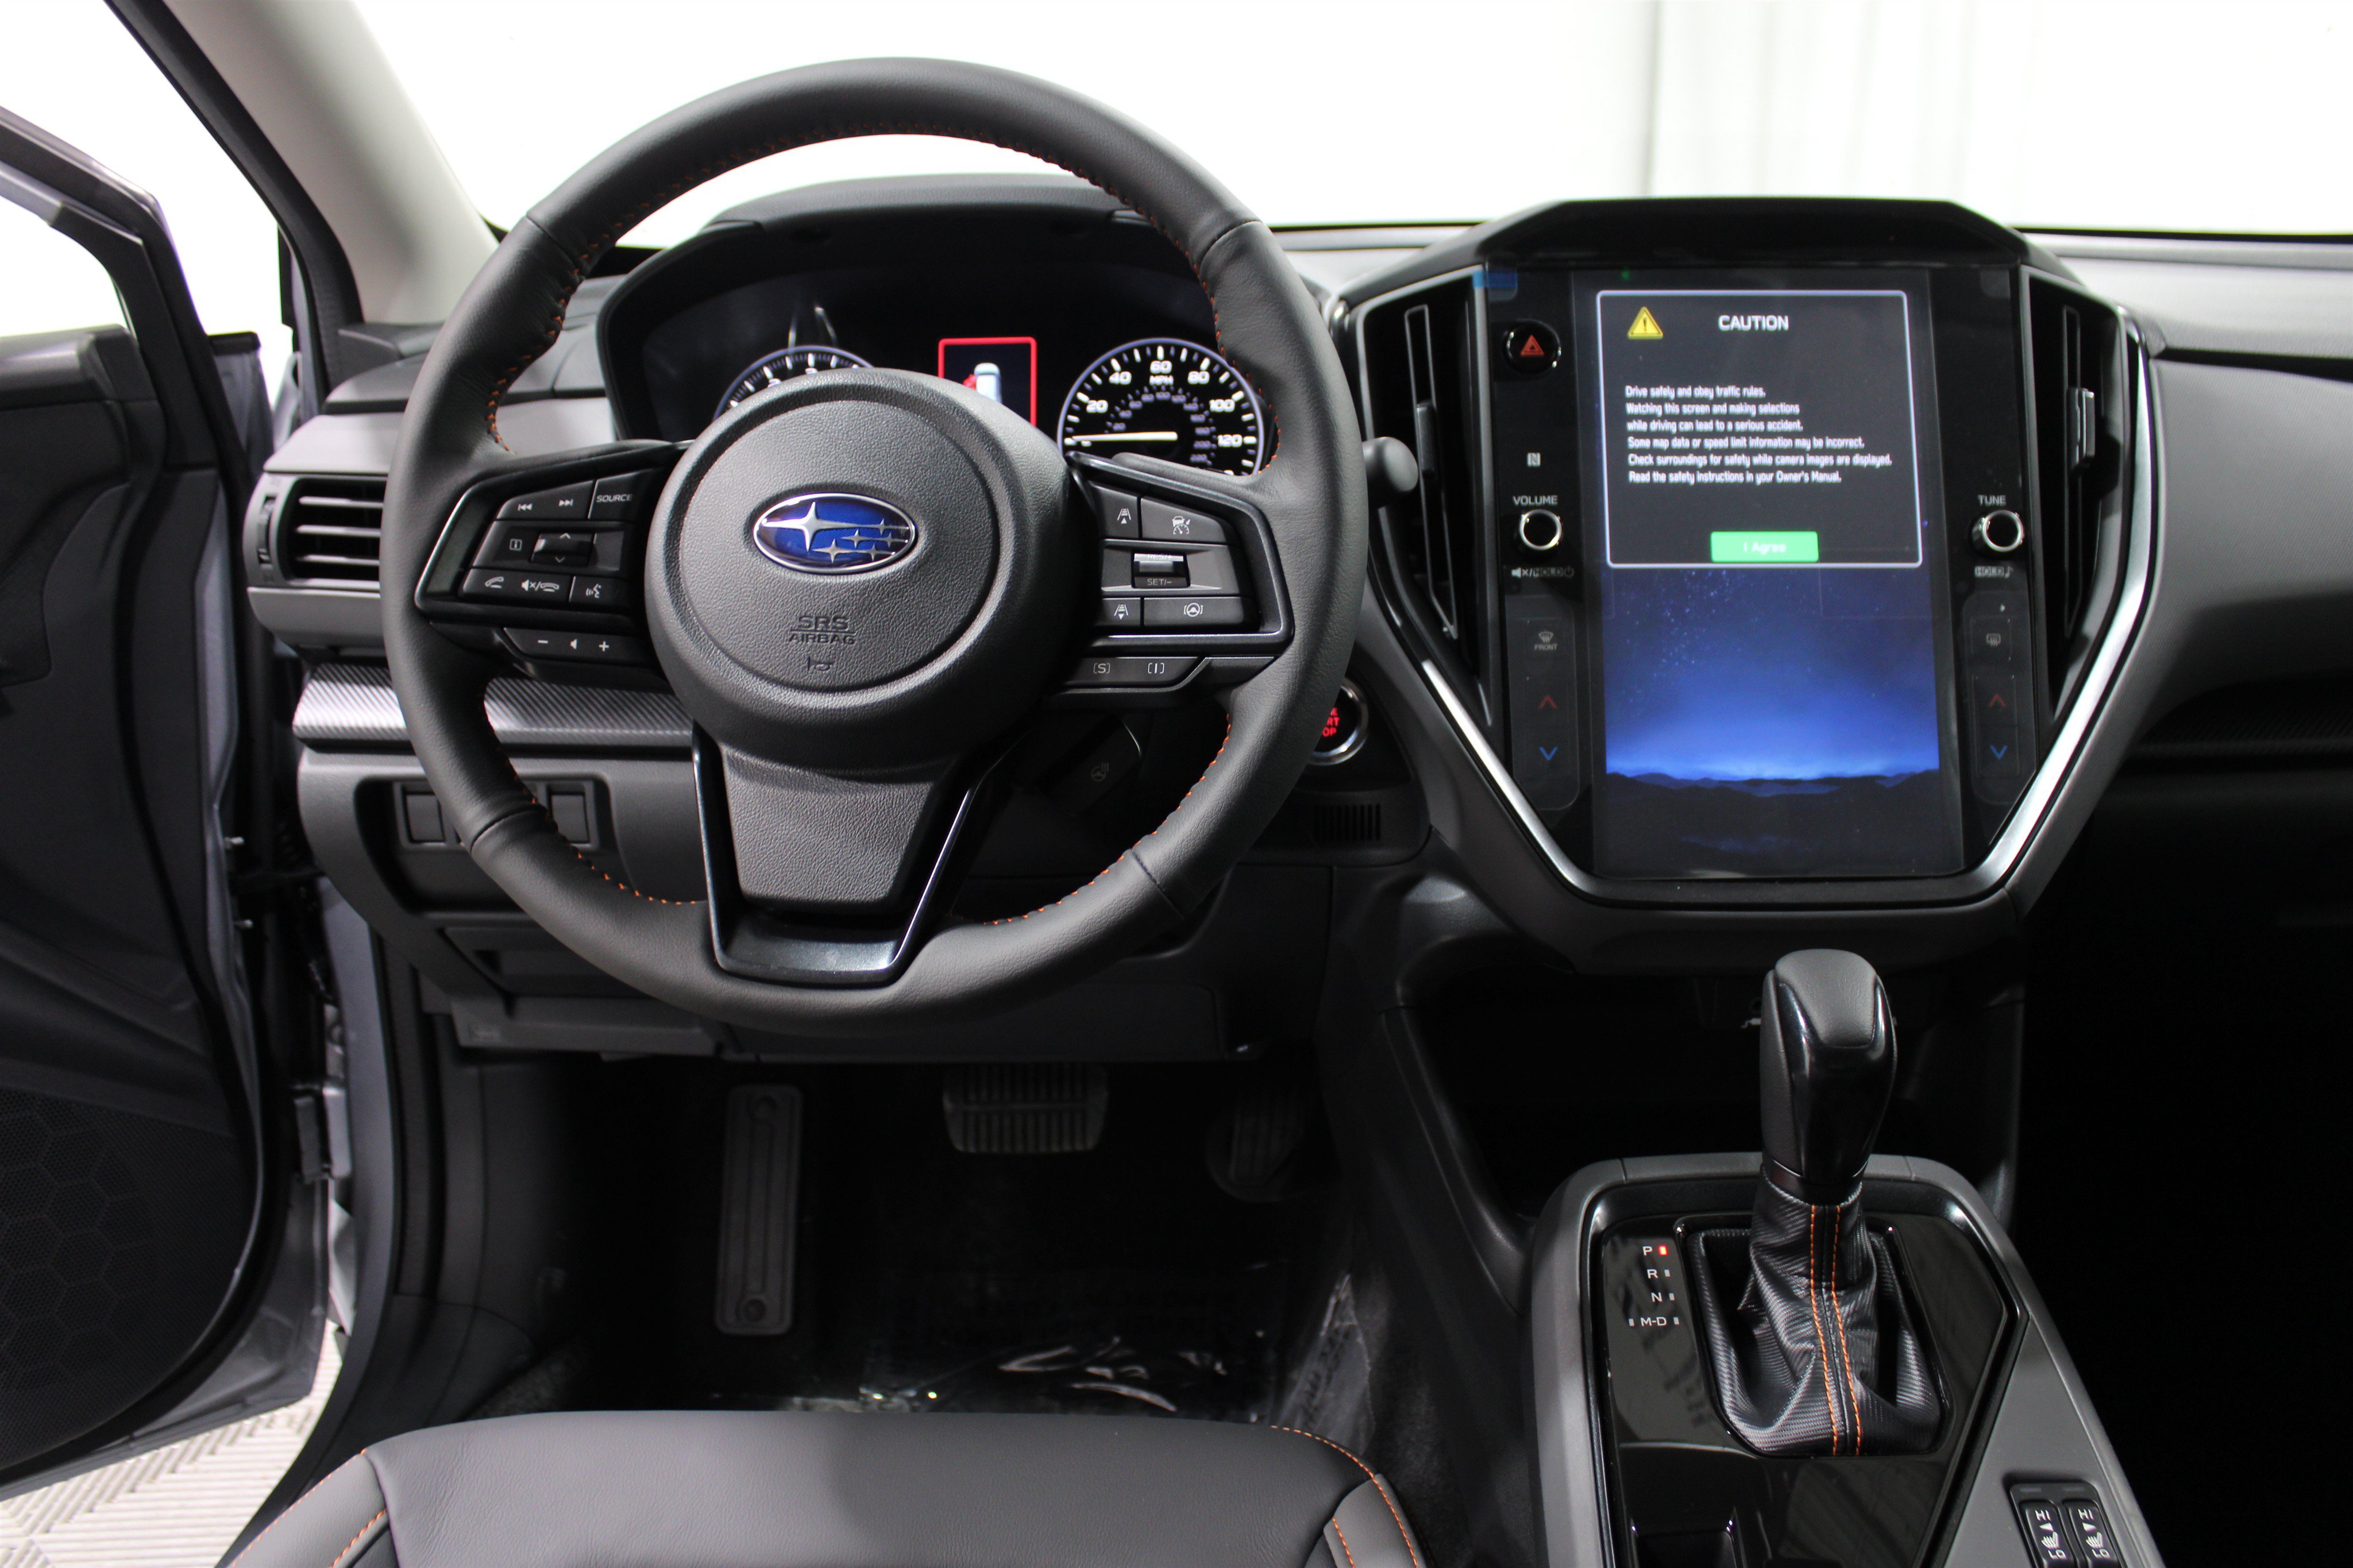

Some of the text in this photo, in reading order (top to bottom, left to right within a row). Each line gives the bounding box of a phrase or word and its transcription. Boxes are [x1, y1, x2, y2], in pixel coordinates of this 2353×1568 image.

[1718, 315, 1789, 331] CAUTION
[1150, 361, 1172, 373] 60
[1109, 371, 1132, 385] 40
[1150, 375, 1174, 385] MPH
[1187, 371, 1210, 384] 80
[1625, 385, 1766, 400] Drive safely and obey traffic rules.
[1086, 400, 1108, 413] 20
[1209, 399, 1235, 412] 100
[1626, 402, 1800, 417] Watching this screen and making selections
[1627, 420, 1803, 434] while driving can lead to a serious accident.
[1217, 434, 1243, 447] 120
[1627, 437, 1865, 451] Some map data or speed limit information may be incorrect.
[1628, 454, 1892, 468] Check surroundings for safety while camera images are displayed.
[1629, 471, 1842, 485] Read the safety instructions in your Owner's Manual.
[596, 494, 632, 503] SOURCE
[1513, 496, 1558, 505] VOLUME
[1978, 495, 2007, 506] TUNE
[1744, 542, 1786, 555] I Agree
[1975, 566, 2004, 577] HOLD
[798, 616, 848, 629] SRS
[789, 633, 855, 644] AIRBAG
[1642, 1246, 1653, 1256] P
[1647, 1269, 1658, 1279] R
[1651, 1292, 1662, 1303] N
[1641, 1316, 1667, 1326] M-D
[2035, 1510, 2051, 1521] HI
[2078, 1509, 2094, 1520] HI
[2048, 1549, 2067, 1559] LO
[2092, 1548, 2112, 1559] LO
